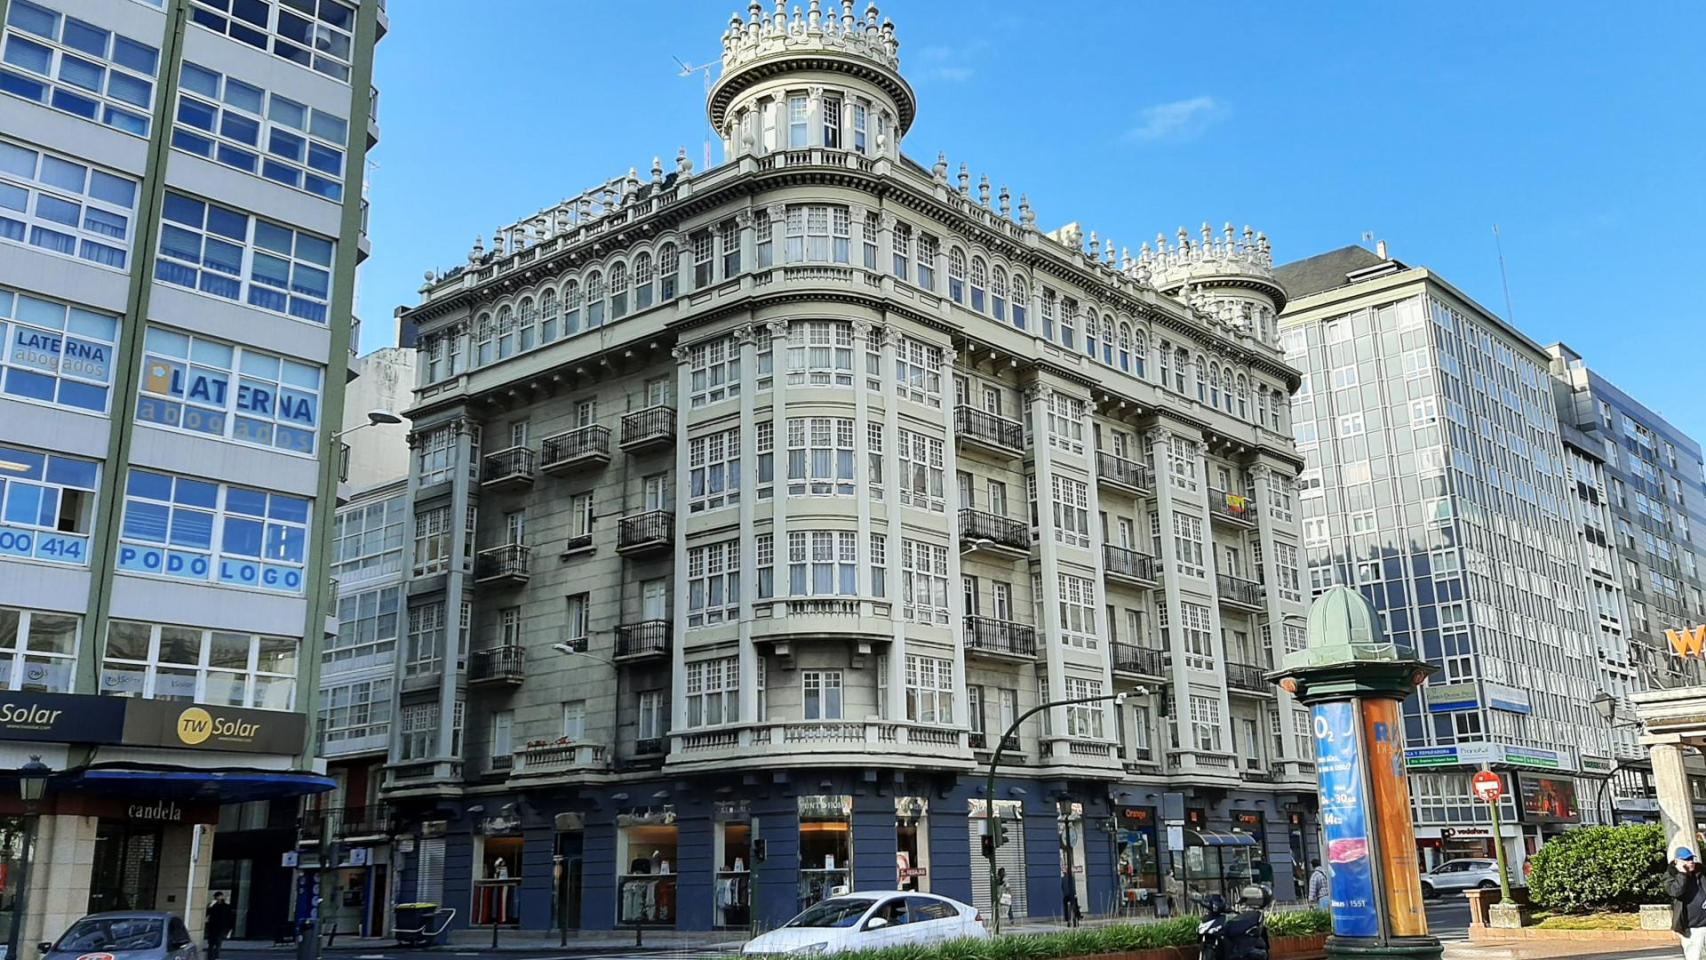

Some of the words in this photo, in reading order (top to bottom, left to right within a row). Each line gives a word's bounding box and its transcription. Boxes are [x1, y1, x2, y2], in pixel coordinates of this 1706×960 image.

[17, 331, 104, 362] LATERNA
[15, 348, 104, 376] abogados
[170, 369, 313, 422] LATERNA
[140, 401, 309, 449] abogados
[41, 537, 81, 559] 414
[120, 548, 299, 588] PODÓLOGO
[0, 703, 62, 724] Solar
[183, 718, 208, 733] TW
[212, 717, 260, 737] Solar
[128, 800, 181, 821] candela
